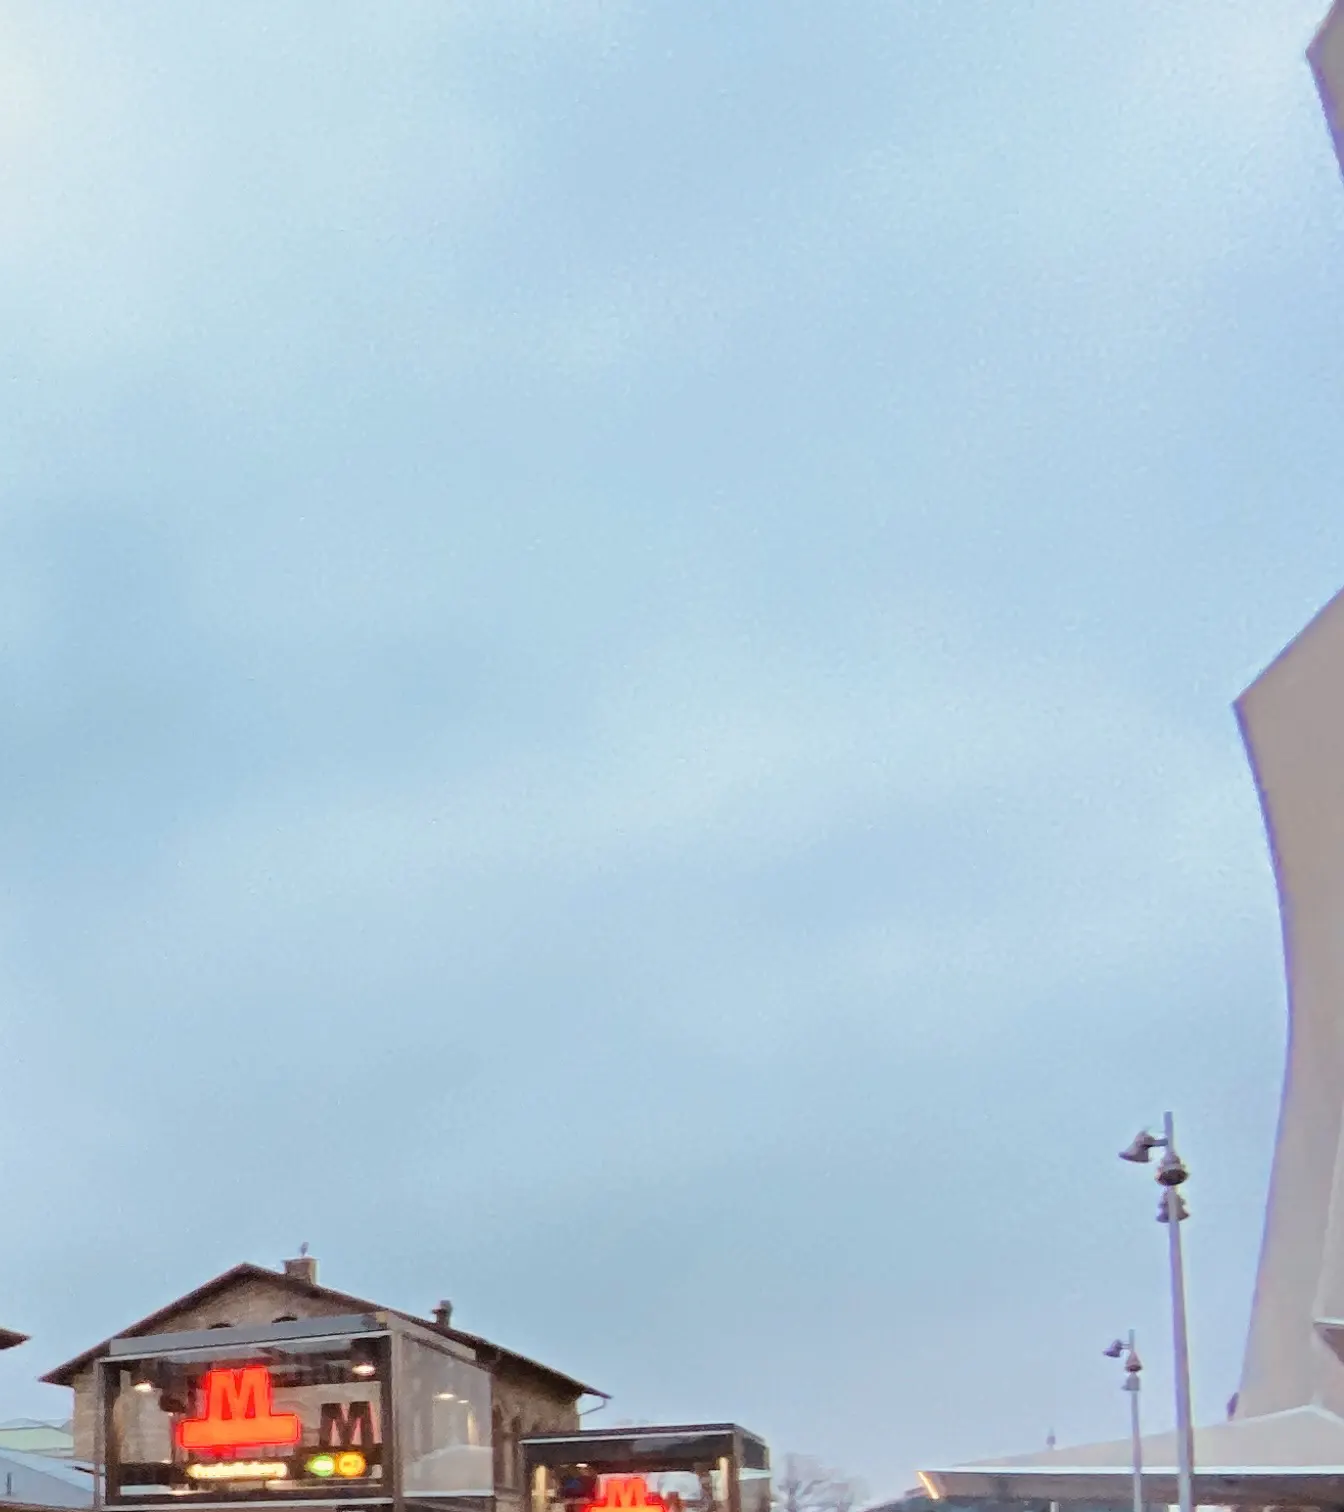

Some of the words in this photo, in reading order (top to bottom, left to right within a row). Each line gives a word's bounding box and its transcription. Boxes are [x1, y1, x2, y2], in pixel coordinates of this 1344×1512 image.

[206, 1367, 270, 1421] M
[320, 1401, 375, 1447] M
[606, 1478, 647, 1508] M
